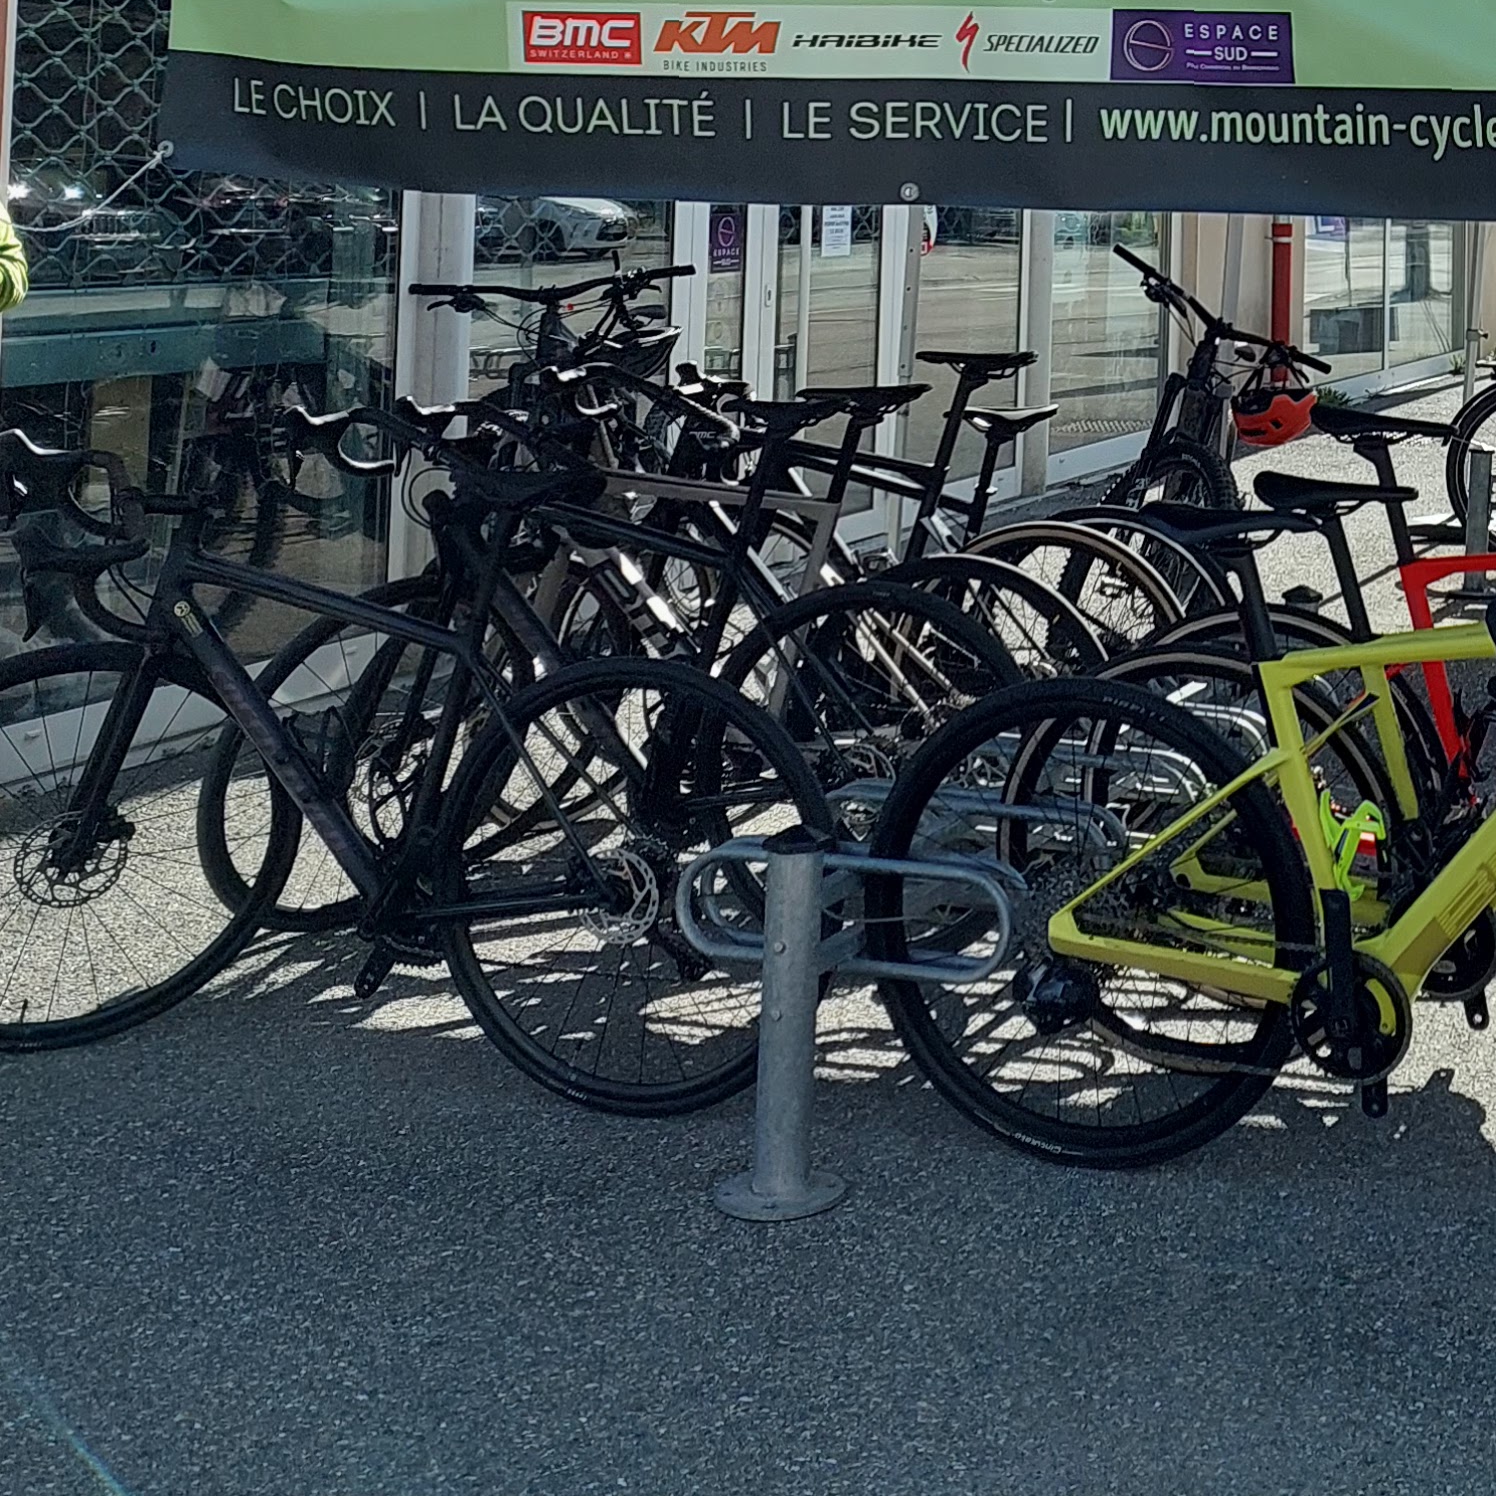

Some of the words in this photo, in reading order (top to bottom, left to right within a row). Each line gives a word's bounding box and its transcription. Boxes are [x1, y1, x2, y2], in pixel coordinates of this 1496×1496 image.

[529, 15, 636, 47] BMC
[652, 11, 782, 54] KTM
[1183, 22, 1279, 41] ESPACE
[982, 34, 1100, 54] SPECIALIZED
[1213, 45, 1249, 62] SUD
[529, 48, 619, 61] SWITZERLAND
[662, 59, 690, 72] BIKE
[695, 60, 768, 73] INDUSTRIES
[232, 77, 266, 115] LE
[272, 83, 397, 127] CHOIX
[453, 93, 507, 131] LA
[517, 90, 716, 138] QUALITÉ
[781, 100, 833, 140] LE
[848, 101, 1049, 143] SERVICE
